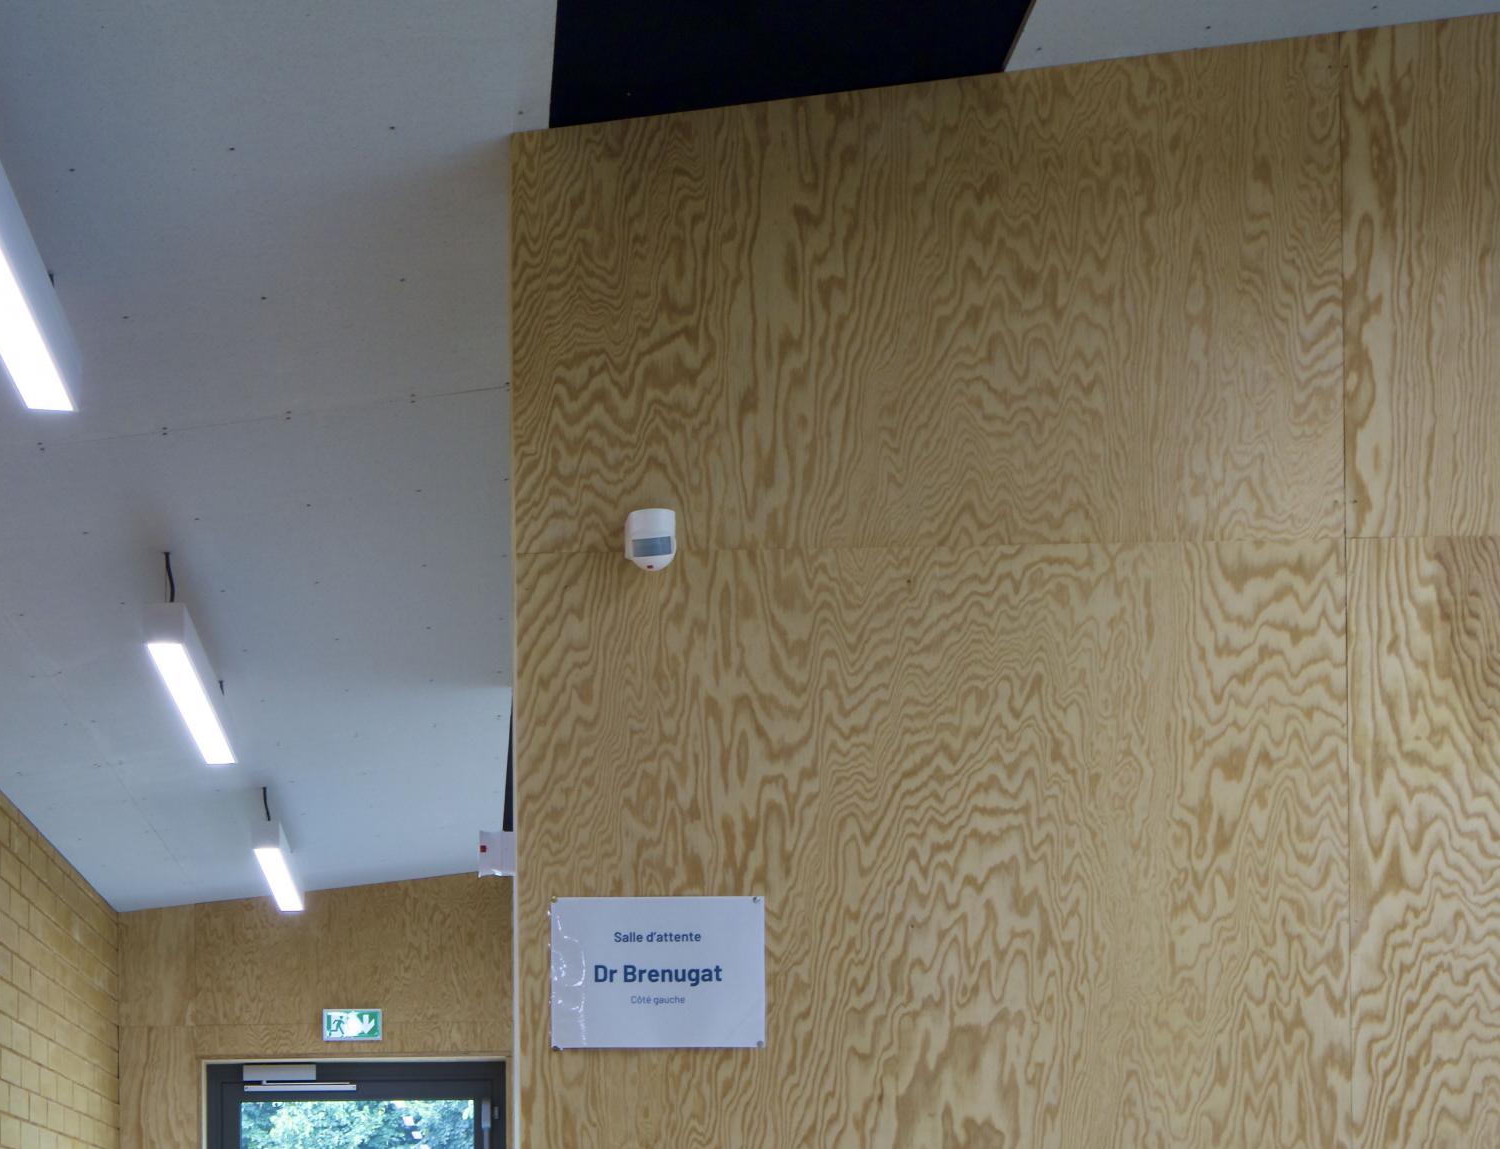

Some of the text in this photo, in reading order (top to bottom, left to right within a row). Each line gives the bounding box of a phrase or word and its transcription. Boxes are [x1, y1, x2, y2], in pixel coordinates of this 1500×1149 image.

[614, 931, 643, 943] Salle
[594, 964, 723, 987] Dr Brenugat
[630, 995, 686, 1006] Côté gauche
